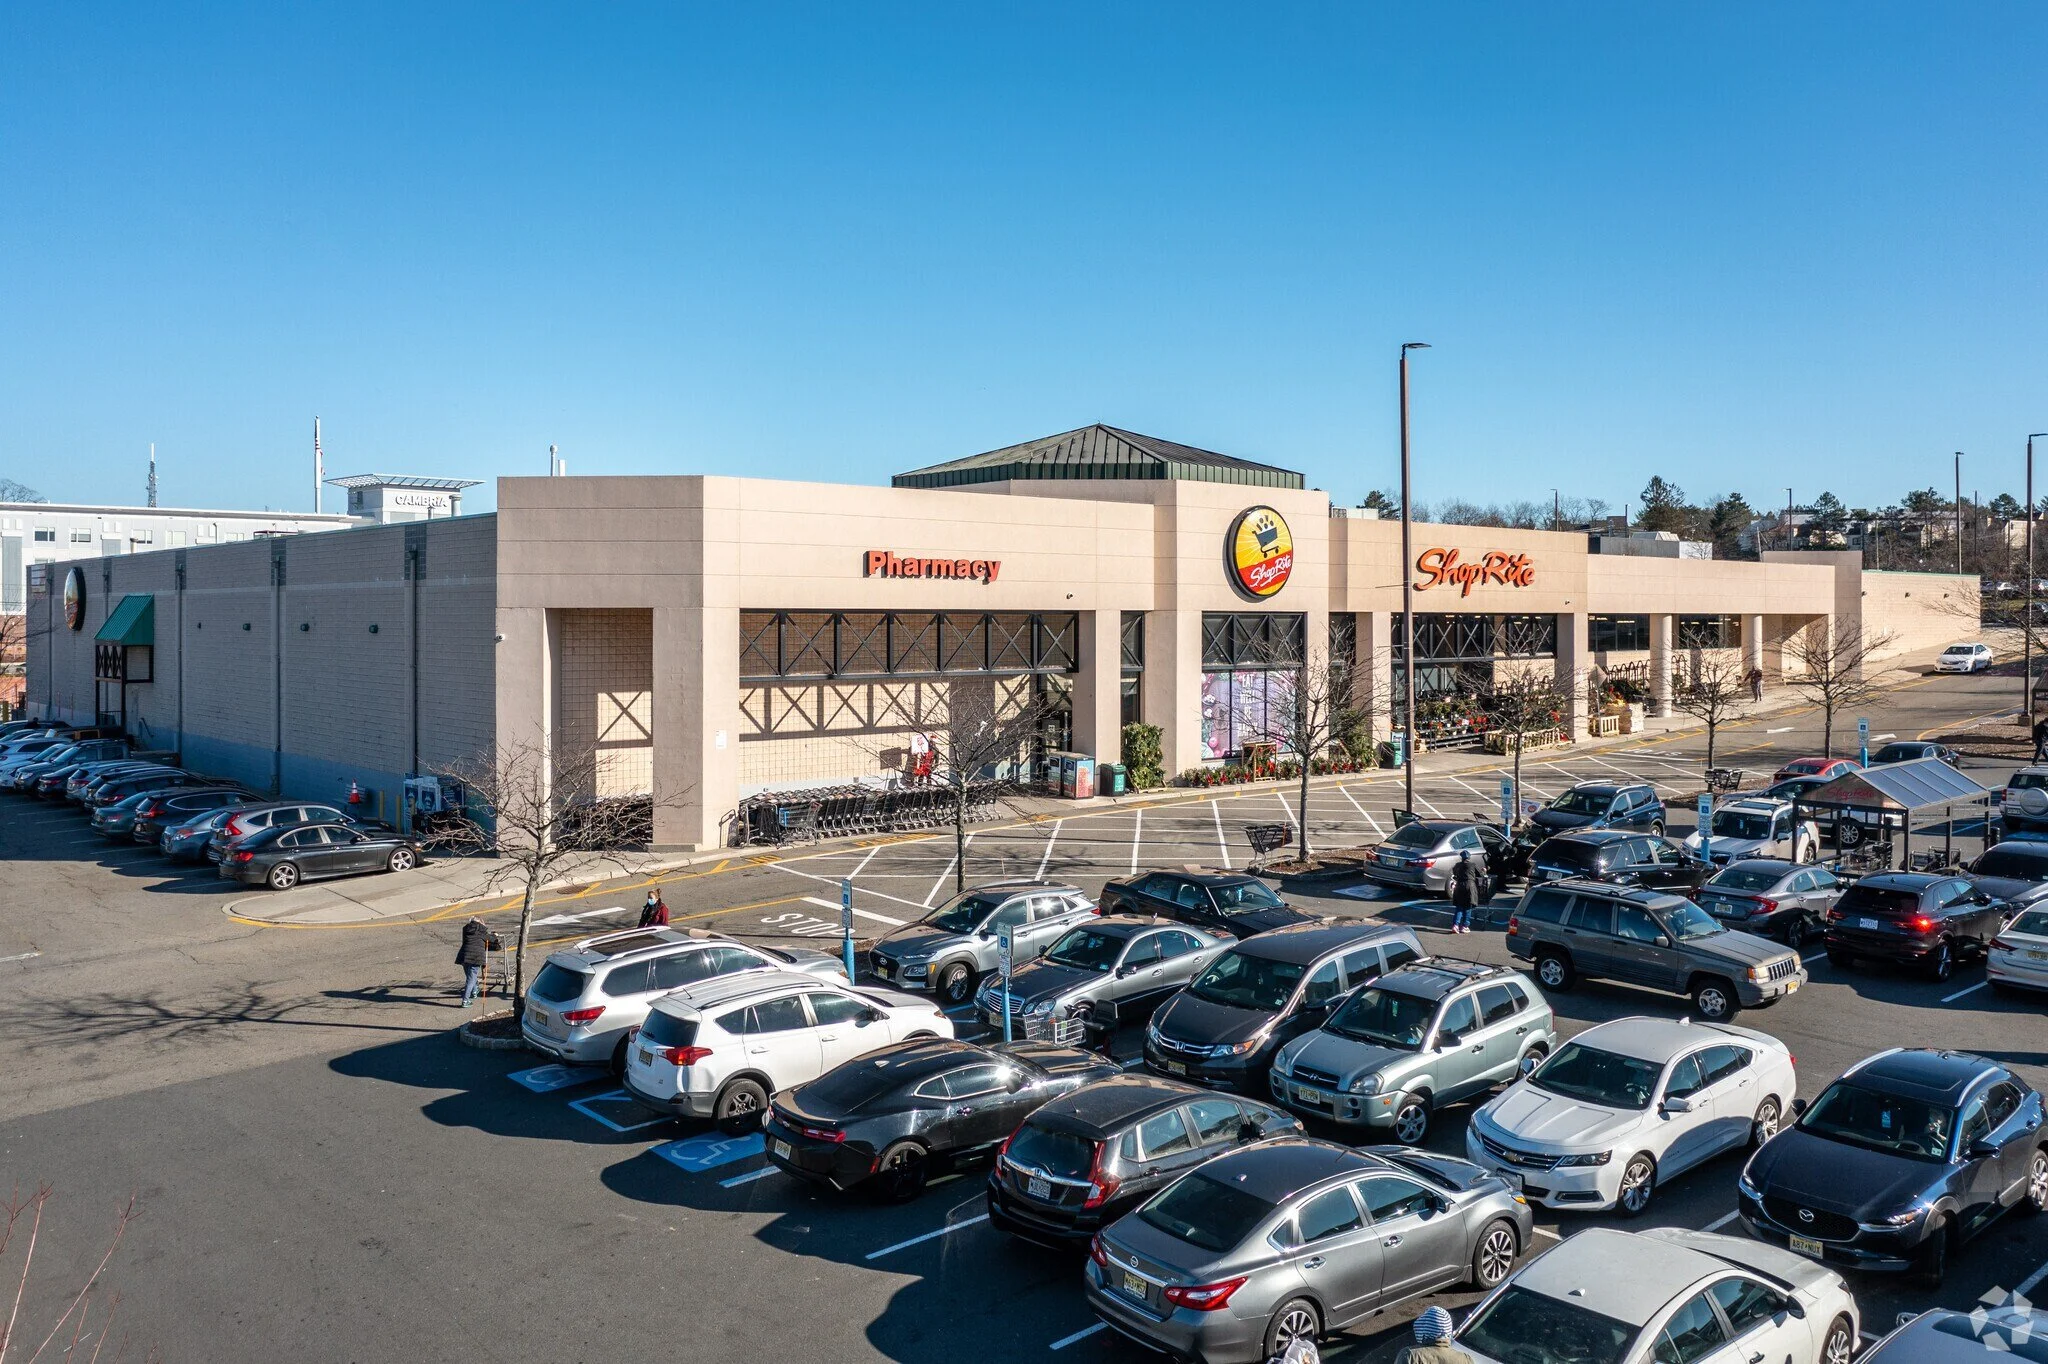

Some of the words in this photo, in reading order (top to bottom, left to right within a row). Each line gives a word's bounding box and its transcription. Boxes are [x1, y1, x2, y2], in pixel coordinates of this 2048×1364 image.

[394, 495, 448, 508] CAMBRIA
[863, 550, 1001, 585] Pharmacy
[1250, 555, 1291, 588] ShopRite
[1413, 548, 1535, 598] ShopRite
[1242, 673, 1255, 688] EAT
[760, 913, 856, 937] STOP
